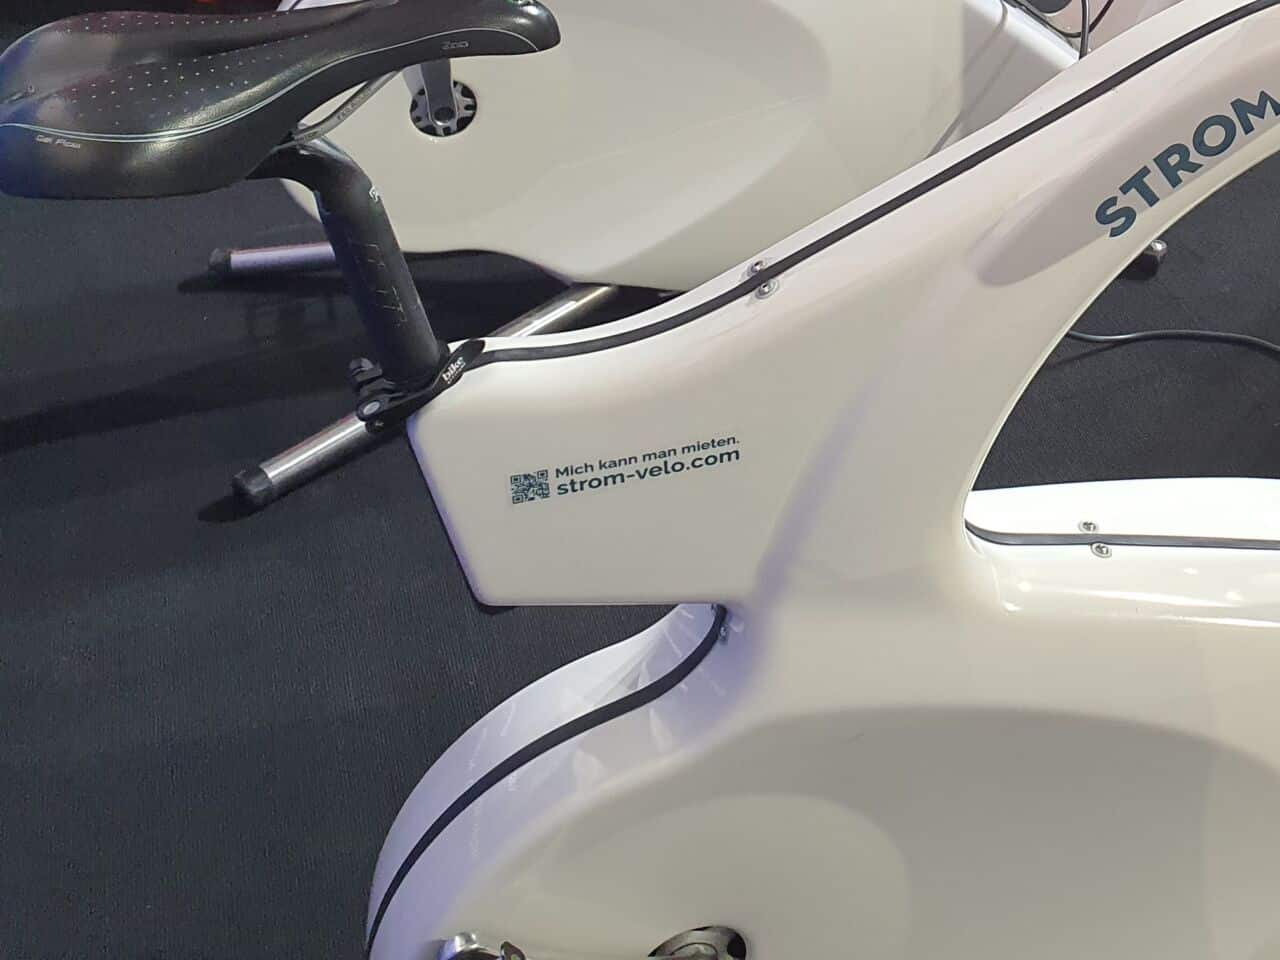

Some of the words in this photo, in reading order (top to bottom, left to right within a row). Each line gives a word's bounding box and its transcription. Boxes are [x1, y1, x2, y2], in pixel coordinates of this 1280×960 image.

[555, 462, 594, 478] Mich
[598, 455, 638, 471] kann
[642, 447, 677, 463] man
[681, 435, 741, 455] mieten.
[556, 448, 741, 496] strom-velo.com
